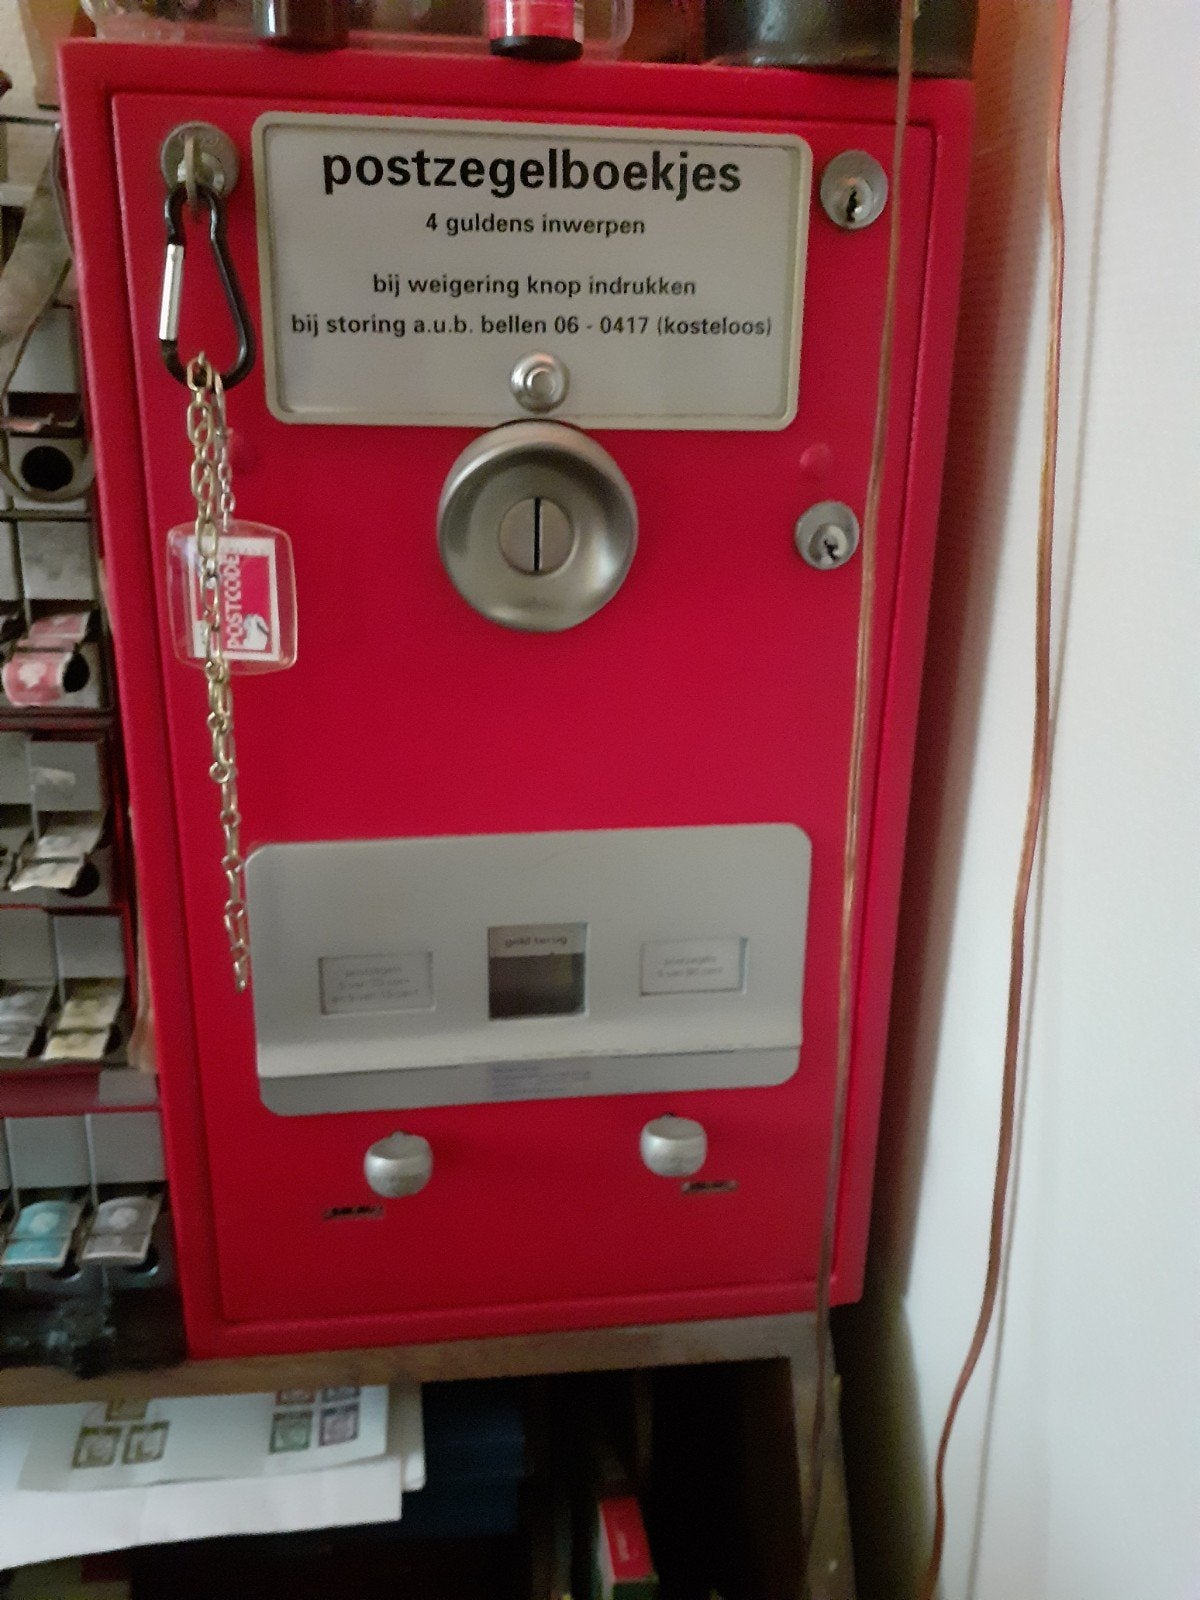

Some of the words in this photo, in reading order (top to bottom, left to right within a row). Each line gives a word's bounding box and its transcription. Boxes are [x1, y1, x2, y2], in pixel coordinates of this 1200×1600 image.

[323, 147, 743, 202] postzegelboekjes
[425, 212, 439, 233] 4
[446, 212, 535, 238] guldens
[542, 212, 646, 239] inwerpen
[372, 272, 401, 298] bij
[408, 273, 520, 299] weigering
[526, 273, 583, 300] knop
[588, 274, 697, 296] indrukken
[291, 313, 320, 339] bij
[326, 313, 407, 339] storing
[413, 313, 474, 335] a.u.b.
[480, 314, 547, 335] bellen
[553, 314, 580, 335] 06
[599, 315, 650, 335] 0417
[656, 315, 773, 338] (kosteloos)
